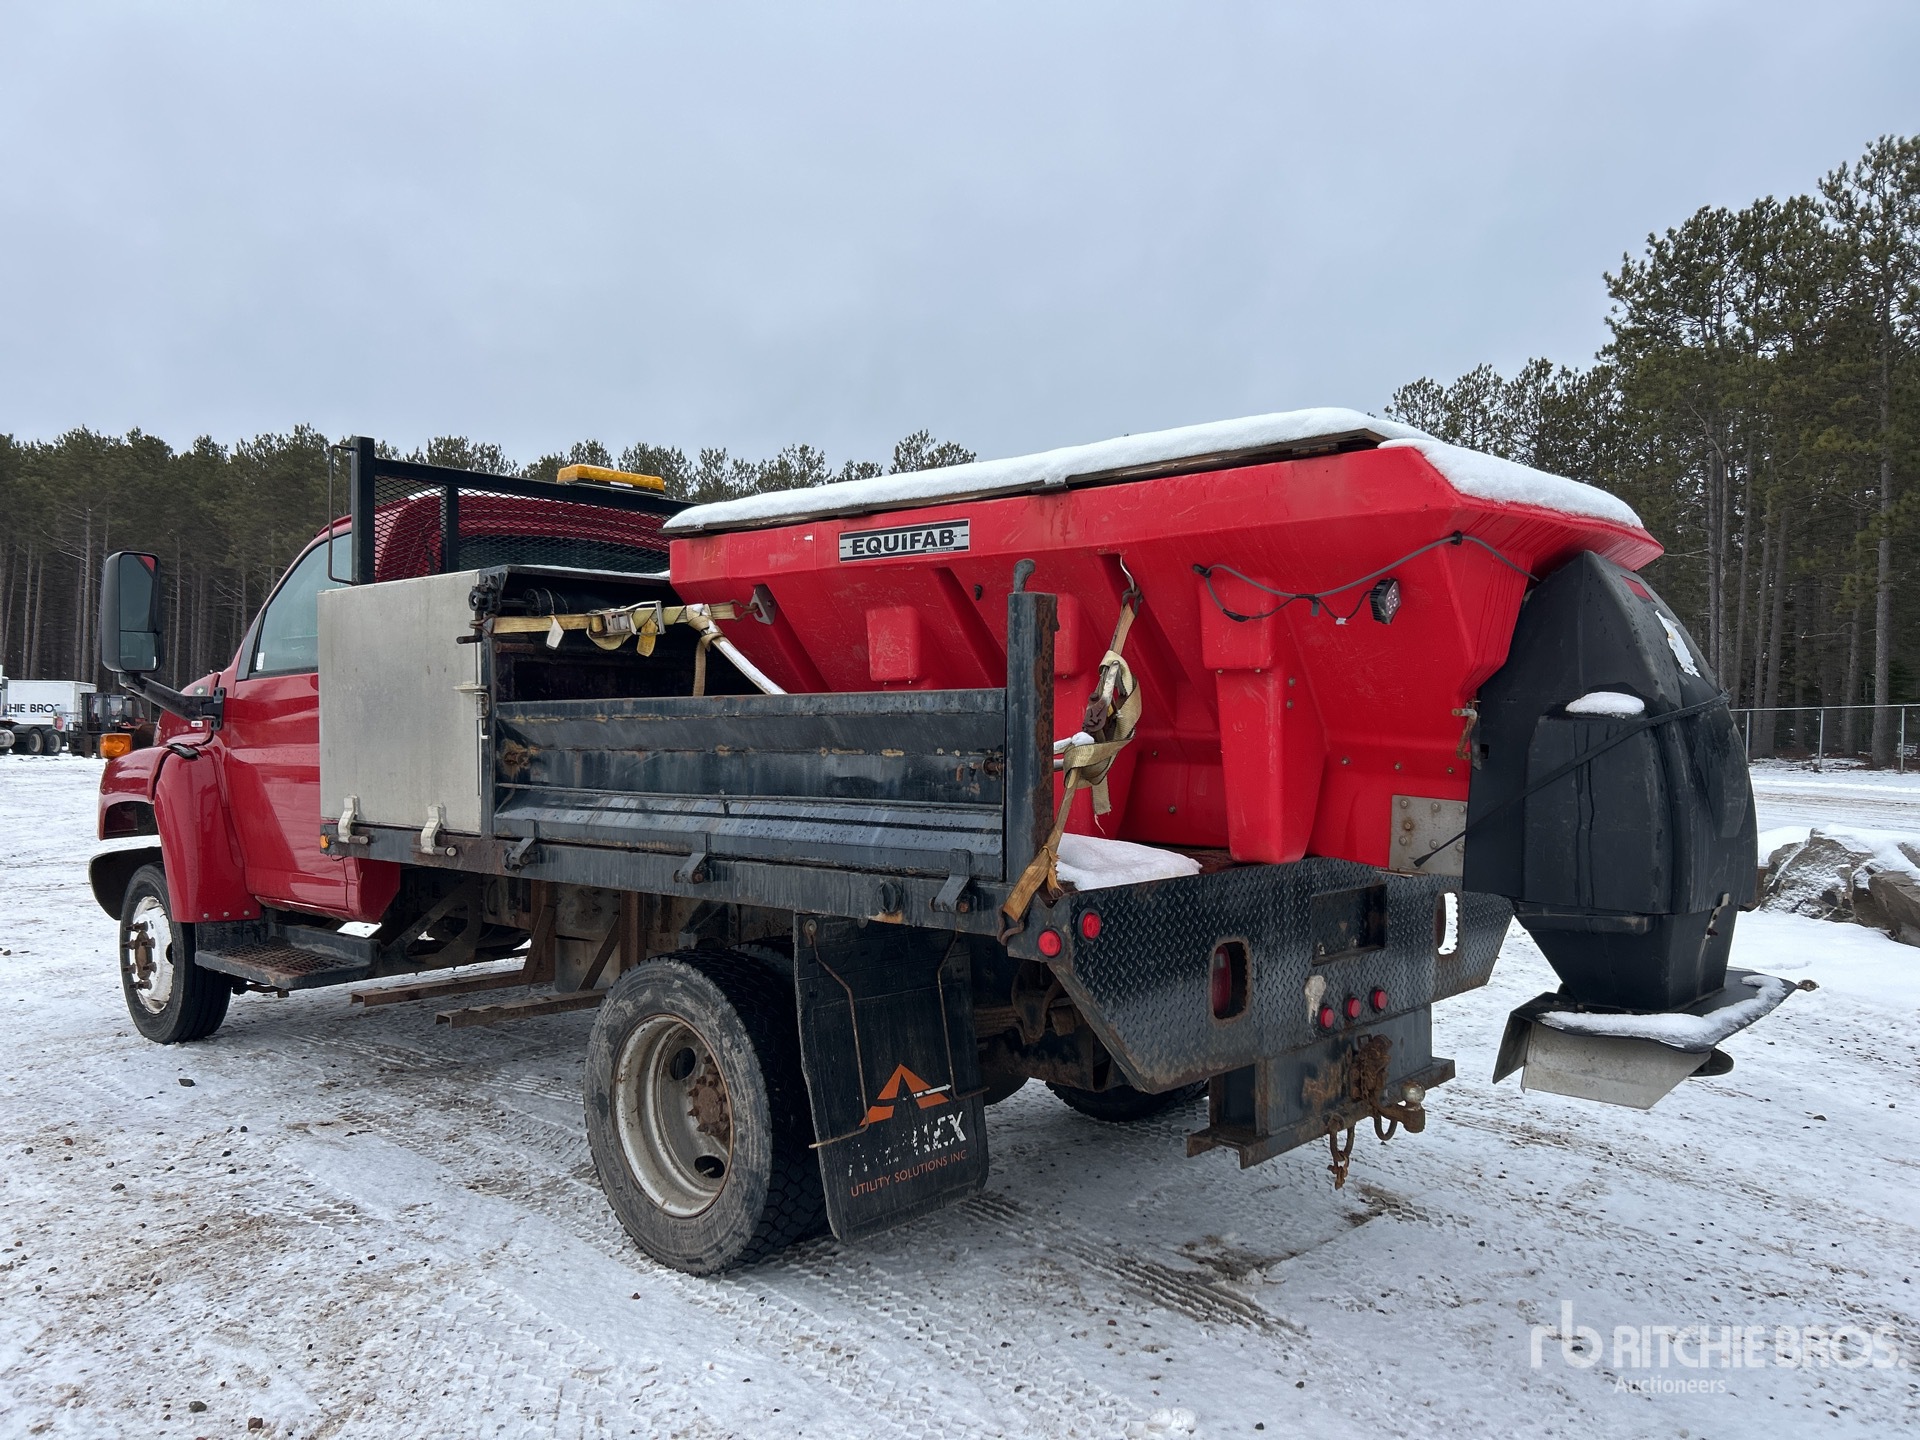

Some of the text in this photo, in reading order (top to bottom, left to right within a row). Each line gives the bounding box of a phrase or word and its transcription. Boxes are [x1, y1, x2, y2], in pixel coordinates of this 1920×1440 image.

[852, 529, 955, 555] EQUIFAB
[7, 703, 26, 713] HIE
[851, 1149, 967, 1197] UTILITY SOLUTIONS INC
